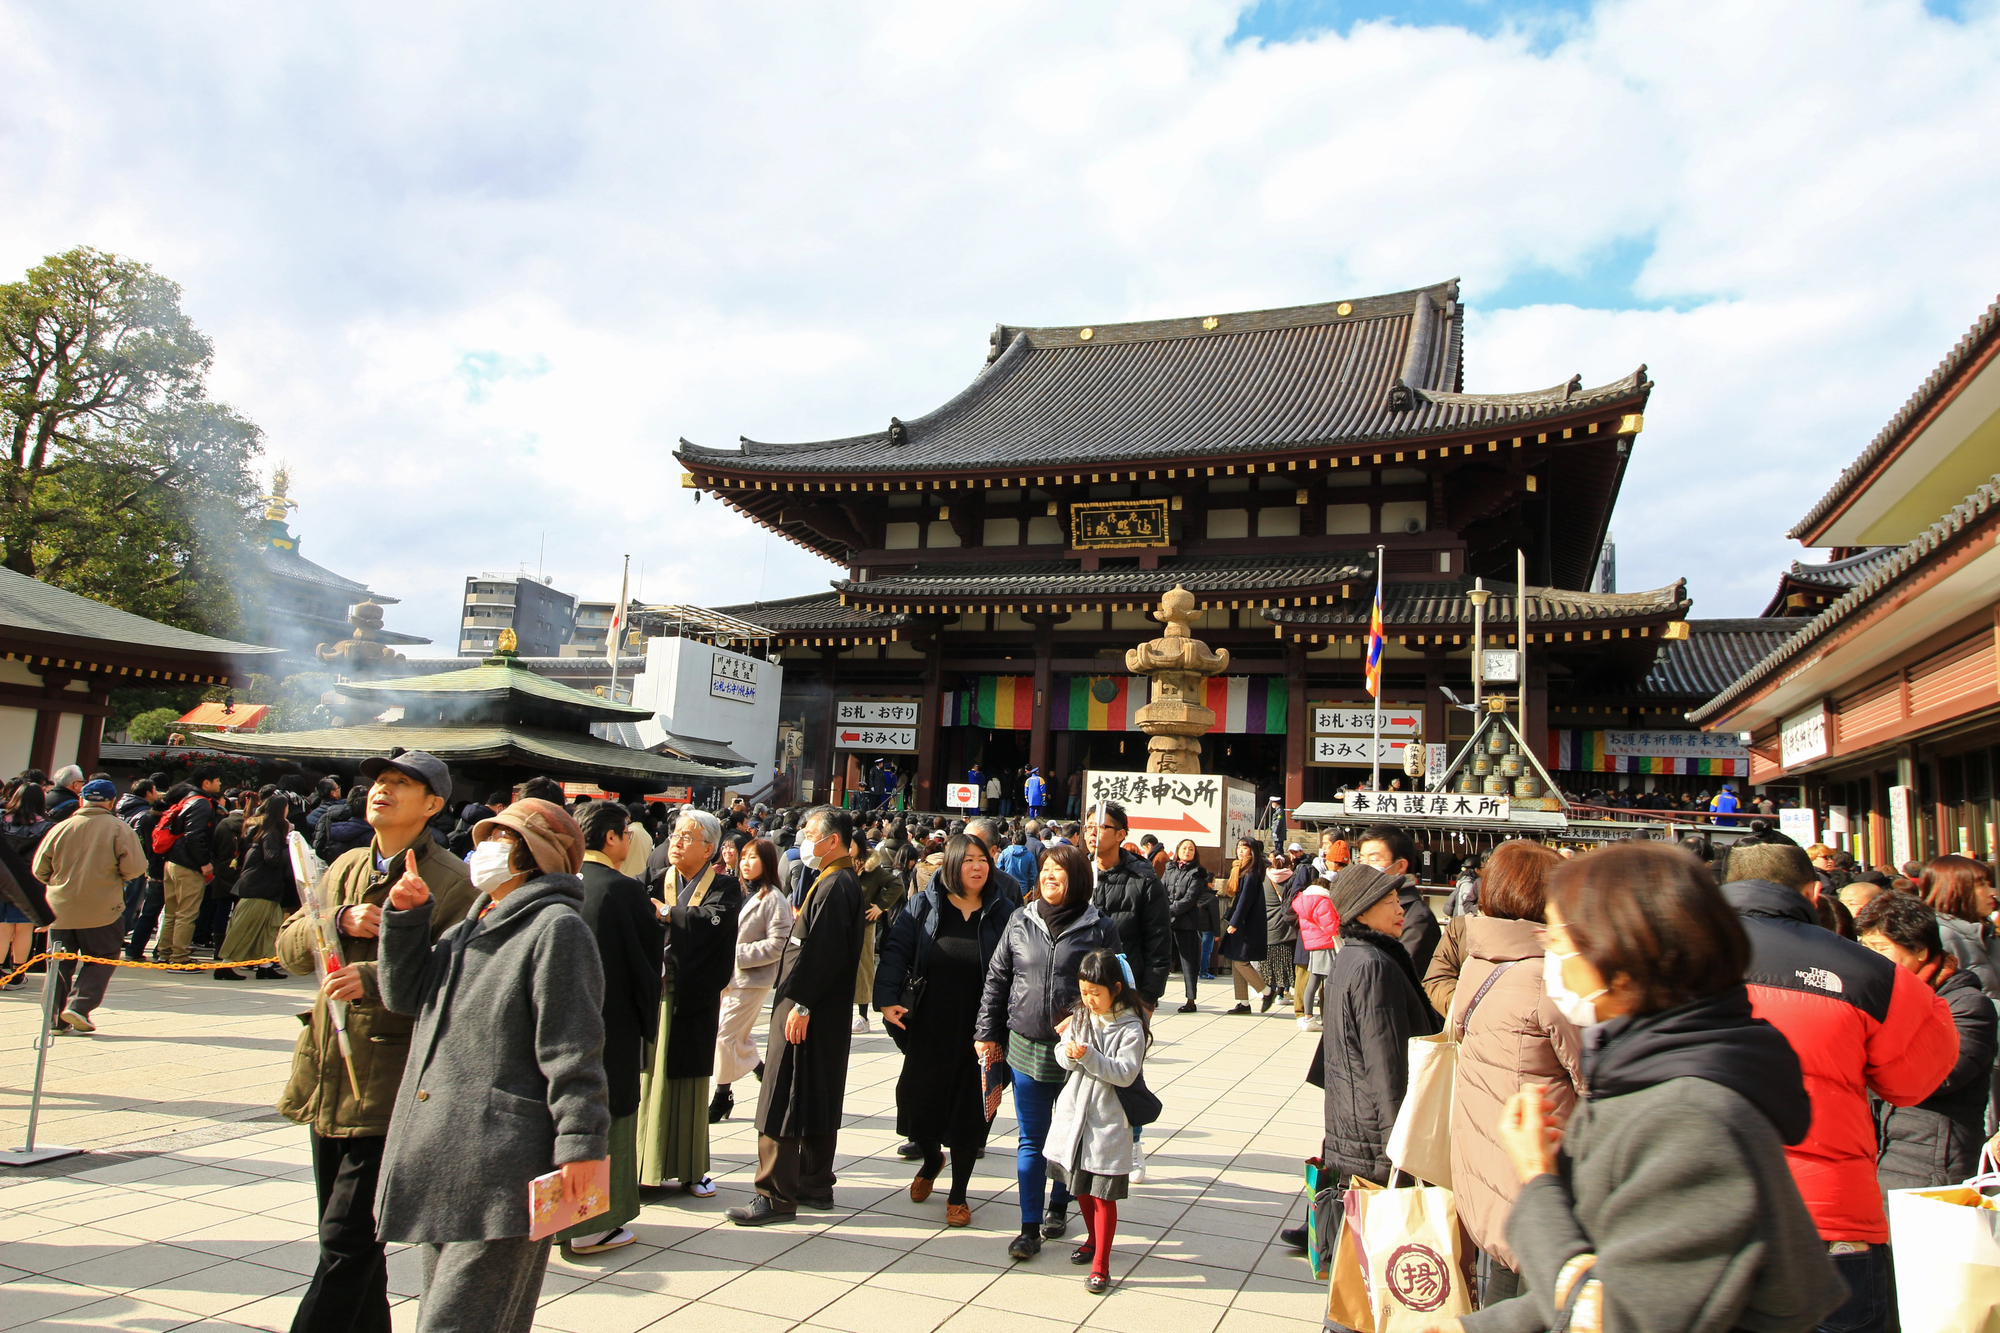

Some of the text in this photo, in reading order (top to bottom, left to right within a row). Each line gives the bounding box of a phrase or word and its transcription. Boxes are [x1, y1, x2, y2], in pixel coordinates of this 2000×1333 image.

[841, 705, 914, 720] お札・お守り
[1319, 713, 1387, 729] お札・お守り
[861, 731, 912, 745] おみくじ
[1157, 753, 1178, 774] 長
[1092, 775, 1219, 809] お護摩申込所
[1352, 793, 1501, 817] 奉納護摩木所
[1795, 970, 1828, 983] NORTH
[1810, 966, 1827, 976] THE
[1803, 978, 1827, 989] FACE
[1401, 1262, 1439, 1297] 揚
